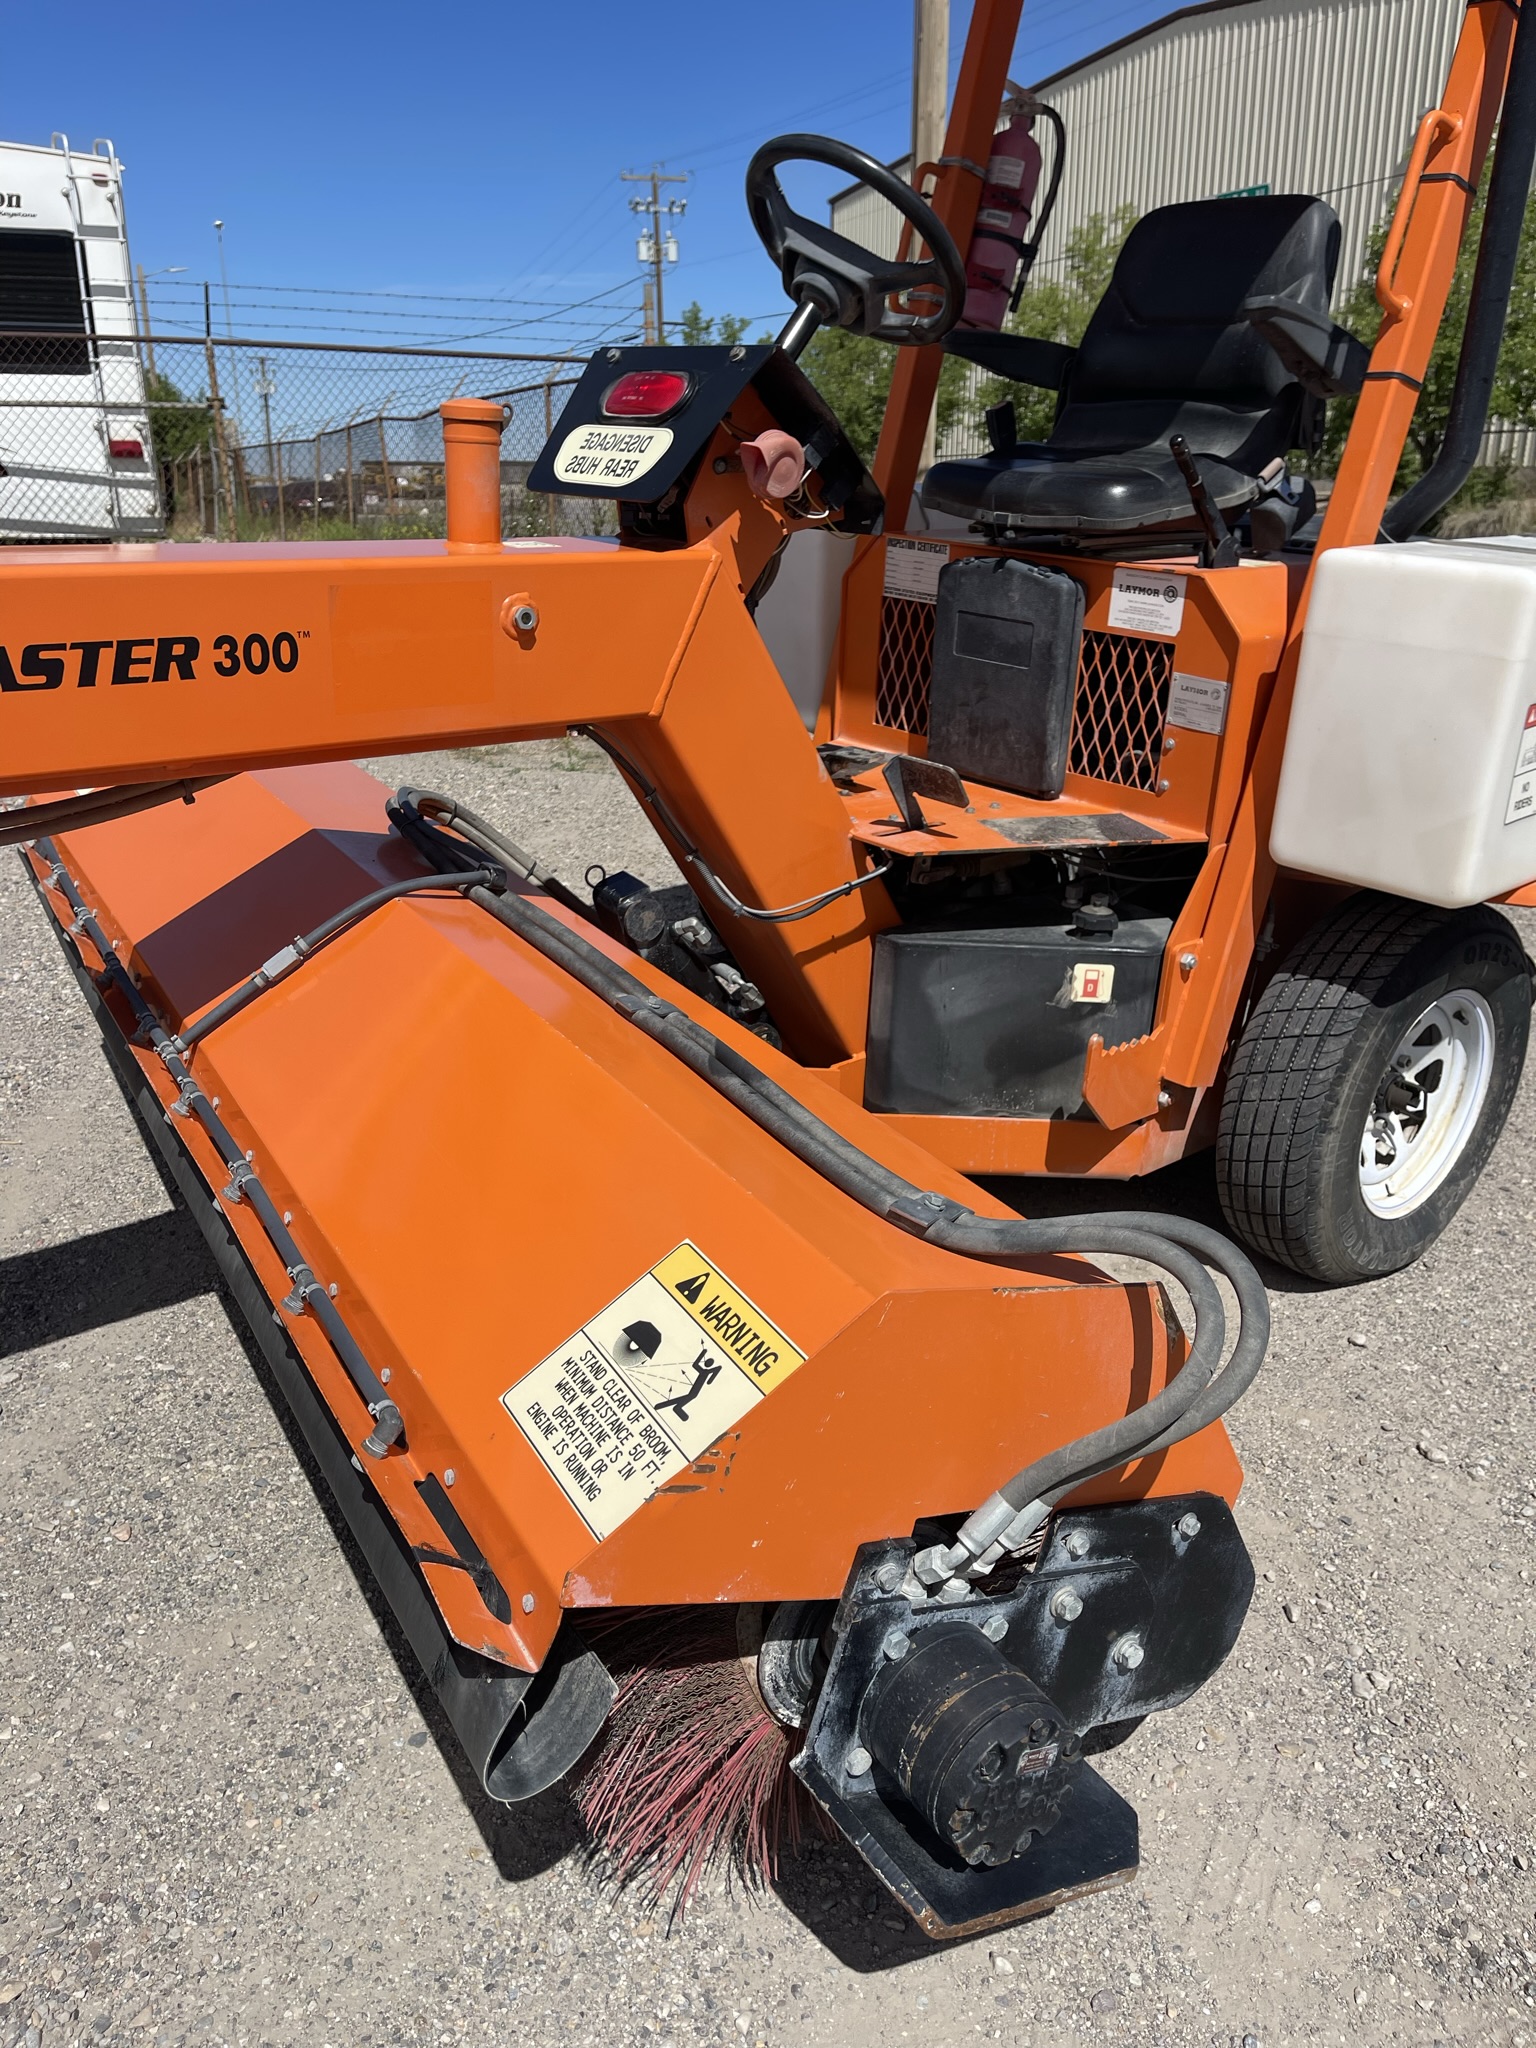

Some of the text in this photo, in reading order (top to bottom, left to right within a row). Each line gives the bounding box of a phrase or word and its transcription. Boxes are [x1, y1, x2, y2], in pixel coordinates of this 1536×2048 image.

[1118, 583, 1160, 597] LAYMOR
[1180, 684, 1208, 695] LAYMOR
[699, 1294, 779, 1378] WARNING
[526, 1401, 602, 1502] ENGINE IS RUNNING
[551, 1404, 609, 1479] OPERATION OR
[554, 1377, 637, 1481] WHEN MACHINE IS IN
[561, 1356, 598, 1400] MINIMUM
[591, 1395, 634, 1447] DISTANCE
[628, 1443, 646, 1462] 50
[580, 1349, 672, 1466] STAND CLEAR OF BROOM,
